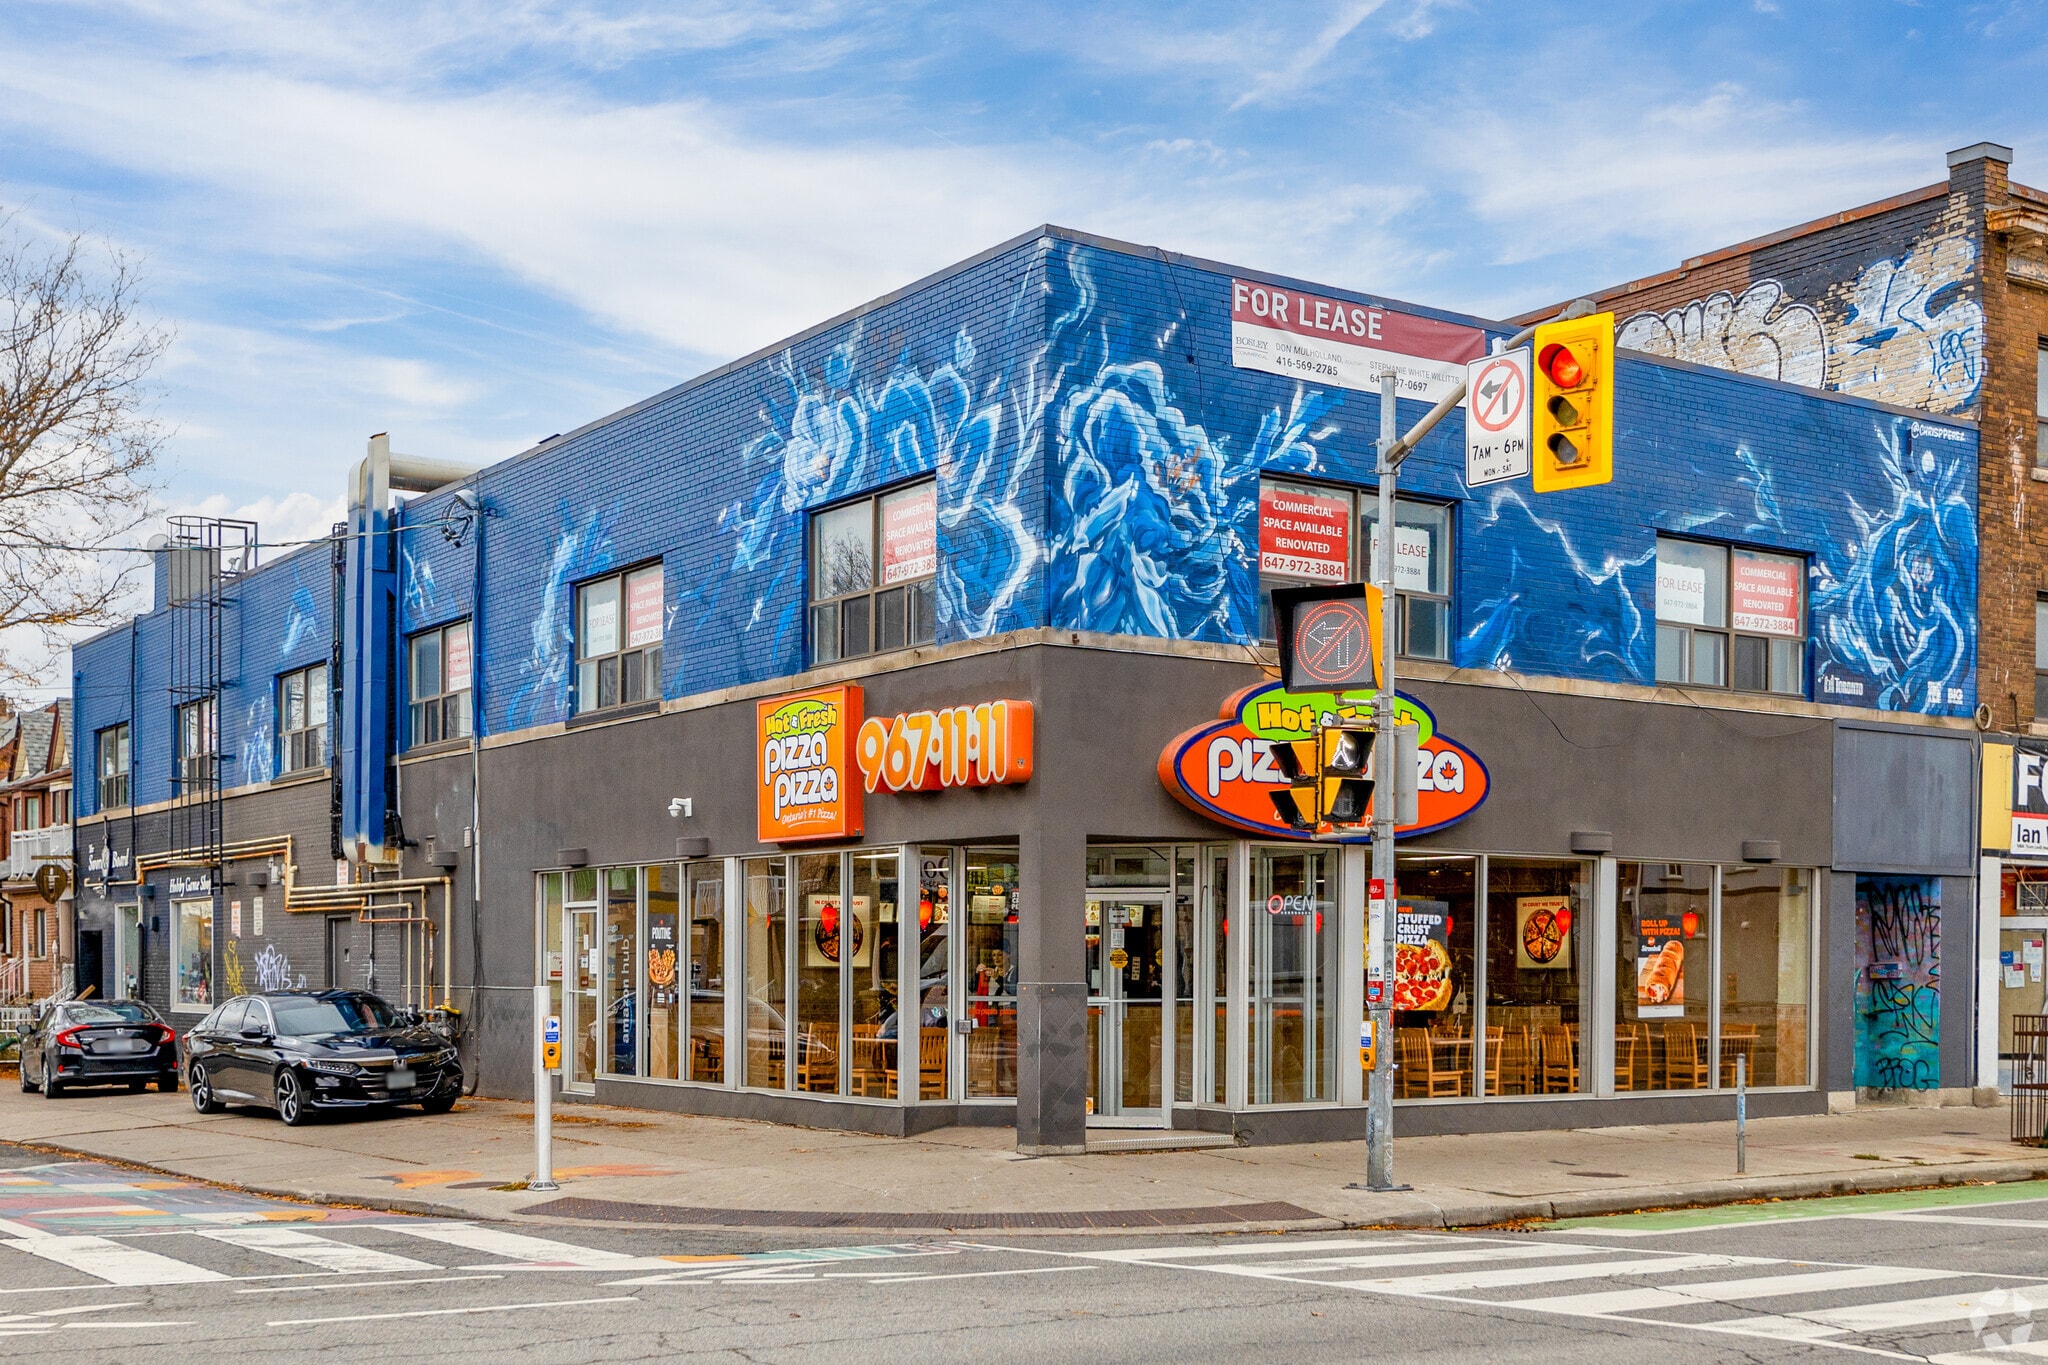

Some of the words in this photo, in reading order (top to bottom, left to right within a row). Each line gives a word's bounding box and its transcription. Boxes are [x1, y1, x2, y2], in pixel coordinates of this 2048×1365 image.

[1234, 283, 1289, 323] FOR
[1299, 297, 1383, 341] LEASE
[1235, 336, 1268, 350] BOSLEY
[1275, 342, 1293, 354] DON
[1276, 355, 1339, 377] 416-569-2785
[1407, 366, 1430, 380] WHITE
[1430, 370, 1461, 385] WILLITTS
[1472, 445, 1491, 461] 7AM
[1504, 438, 1524, 454] 6PM
[892, 501, 935, 521] COMMERCIAL
[1272, 499, 1334, 518] COMMERCIAL
[886, 528, 906, 541] SPACE
[1263, 516, 1292, 531] SPACE
[1293, 521, 1343, 538] AVAILABLE
[895, 538, 932, 557] RENOVATED
[1275, 536, 1330, 554] RENOVATED
[1397, 542, 1428, 558] LEASE
[887, 557, 936, 580] 647-972-388
[1263, 556, 1343, 577] 647-972-3884
[1740, 566, 1787, 581] COMMERCIAL
[1657, 576, 1675, 590] FOR
[1677, 579, 1703, 594] LEASE
[1734, 581, 1756, 593] SPACE
[1756, 584, 1794, 598] AVAILABLE
[1743, 598, 1785, 612] RENOVATED
[1734, 616, 1794, 632] 647-972-3884
[1948, 687, 1963, 700] BIG
[765, 711, 790, 737] Hot
[791, 714, 798, 729] &
[798, 703, 838, 732] Fresh
[1256, 701, 1316, 732] Hot
[2018, 754, 2048, 807] F
[807, 808, 817, 819] #1
[2017, 823, 2041, 844] Ian
[169, 877, 185, 897] Hobby
[185, 876, 200, 892] Game
[200, 874, 211, 895] Shop
[1267, 894, 1314, 914] OPEN
[1397, 913, 1442, 925] STUFFED
[1641, 919, 1658, 927] ROLL
[1658, 919, 1668, 927] UP
[651, 926, 672, 940] POUTINE
[1397, 923, 1431, 935] CRUST
[1641, 927, 1659, 936] WITH
[1660, 927, 1681, 936] PIZZA!
[1397, 934, 1428, 944] PIZZA
[621, 938, 630, 974] hub
[622, 978, 630, 1044] amazon
